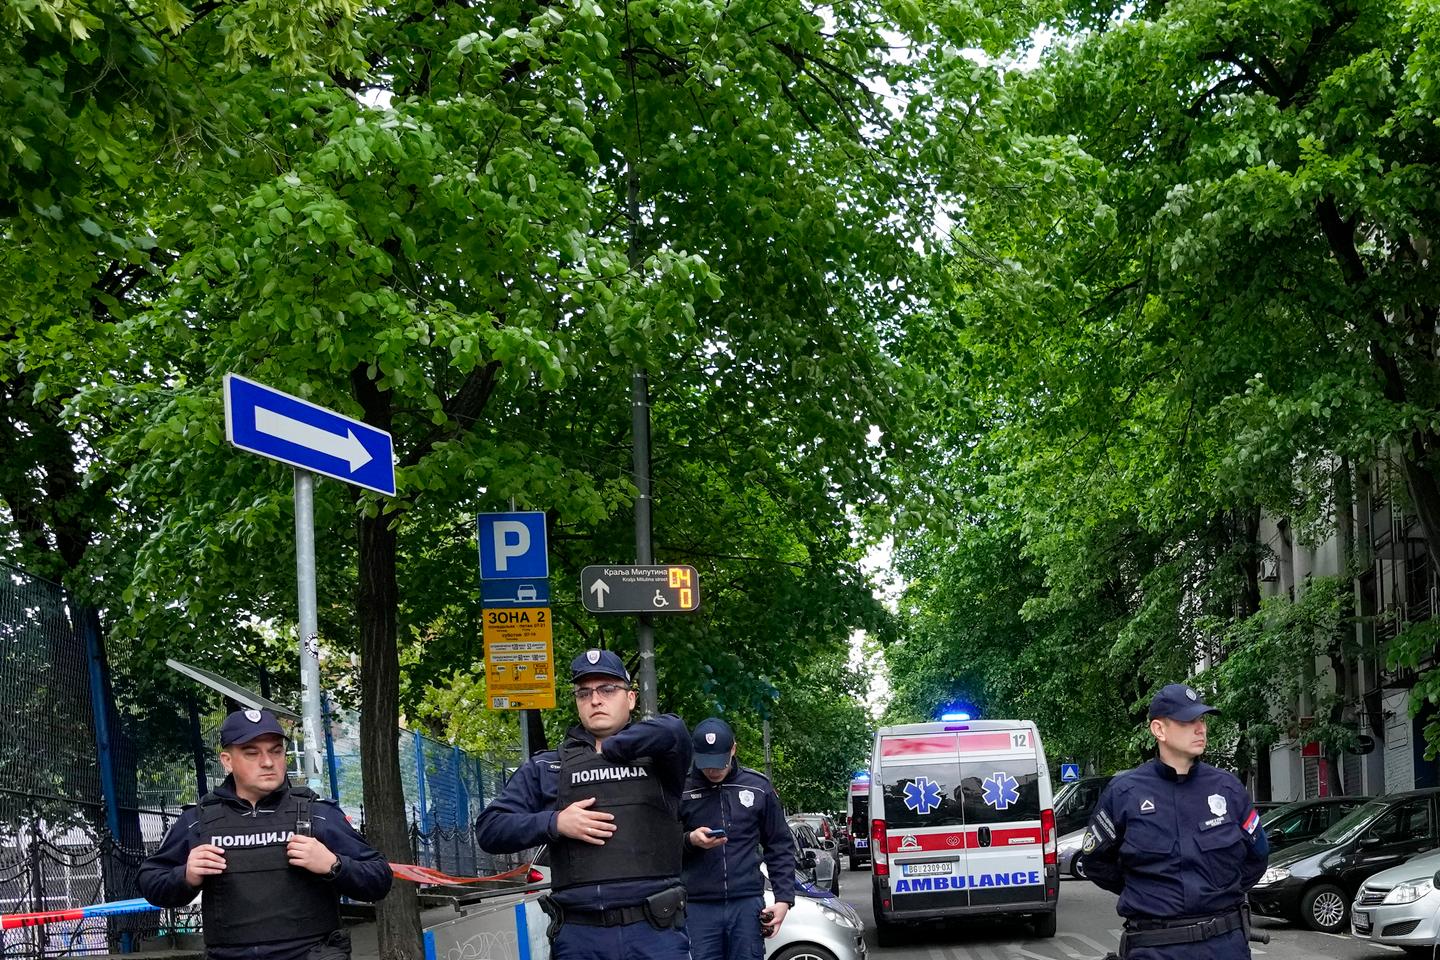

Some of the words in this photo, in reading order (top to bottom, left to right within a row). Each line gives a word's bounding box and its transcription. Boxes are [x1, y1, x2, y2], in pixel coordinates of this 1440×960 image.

[493, 521, 531, 571] P
[604, 568, 630, 577] Краља
[631, 567, 668, 577] Милутина
[680, 588, 692, 608] 0
[489, 612, 530, 624] ЗОНА
[537, 611, 545, 622] 2
[1013, 734, 1027, 747] 12
[572, 767, 648, 784] ПОЛИЦИЈА
[211, 831, 296, 847] ПОЛИЦИЈА
[895, 871, 1040, 892] AMBULANCE
